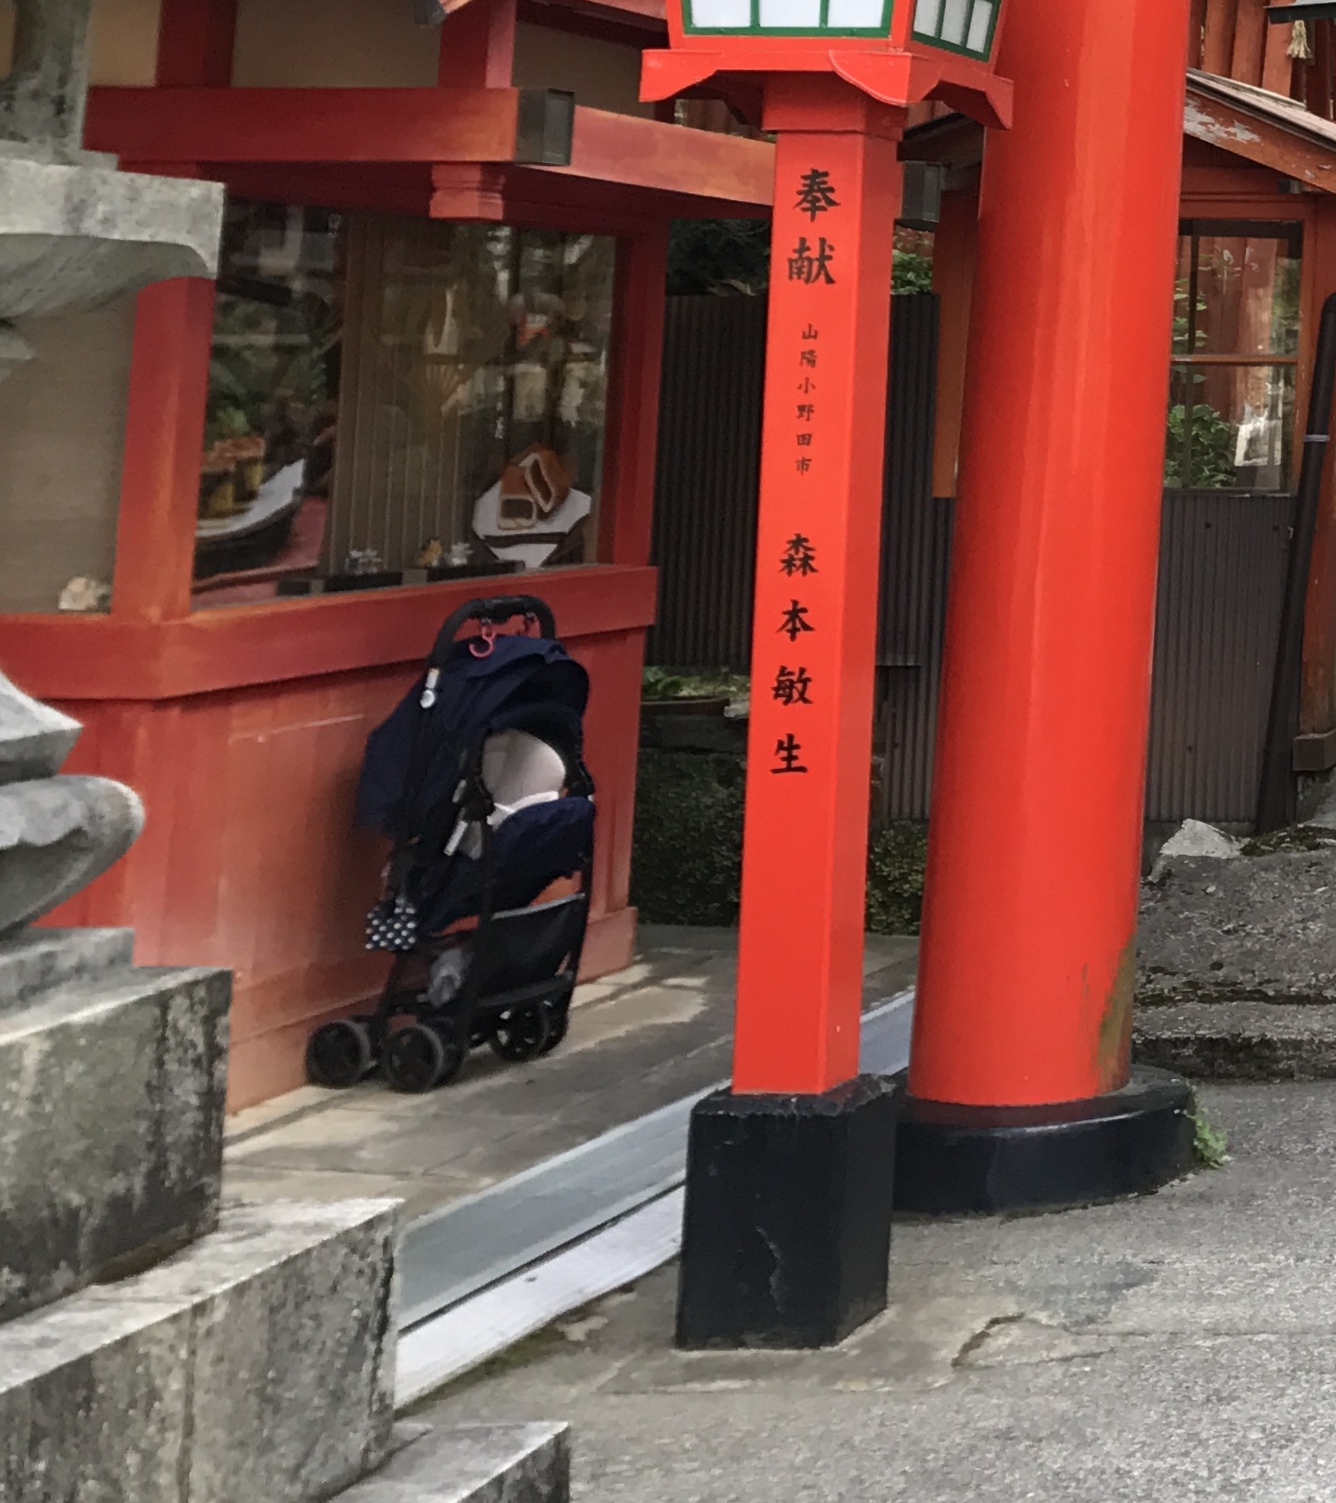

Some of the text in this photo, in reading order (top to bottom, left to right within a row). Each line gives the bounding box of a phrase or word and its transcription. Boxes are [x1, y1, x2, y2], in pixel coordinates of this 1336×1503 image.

[770, 167, 842, 775] 奉献 山陽小野田市 森本敏生
